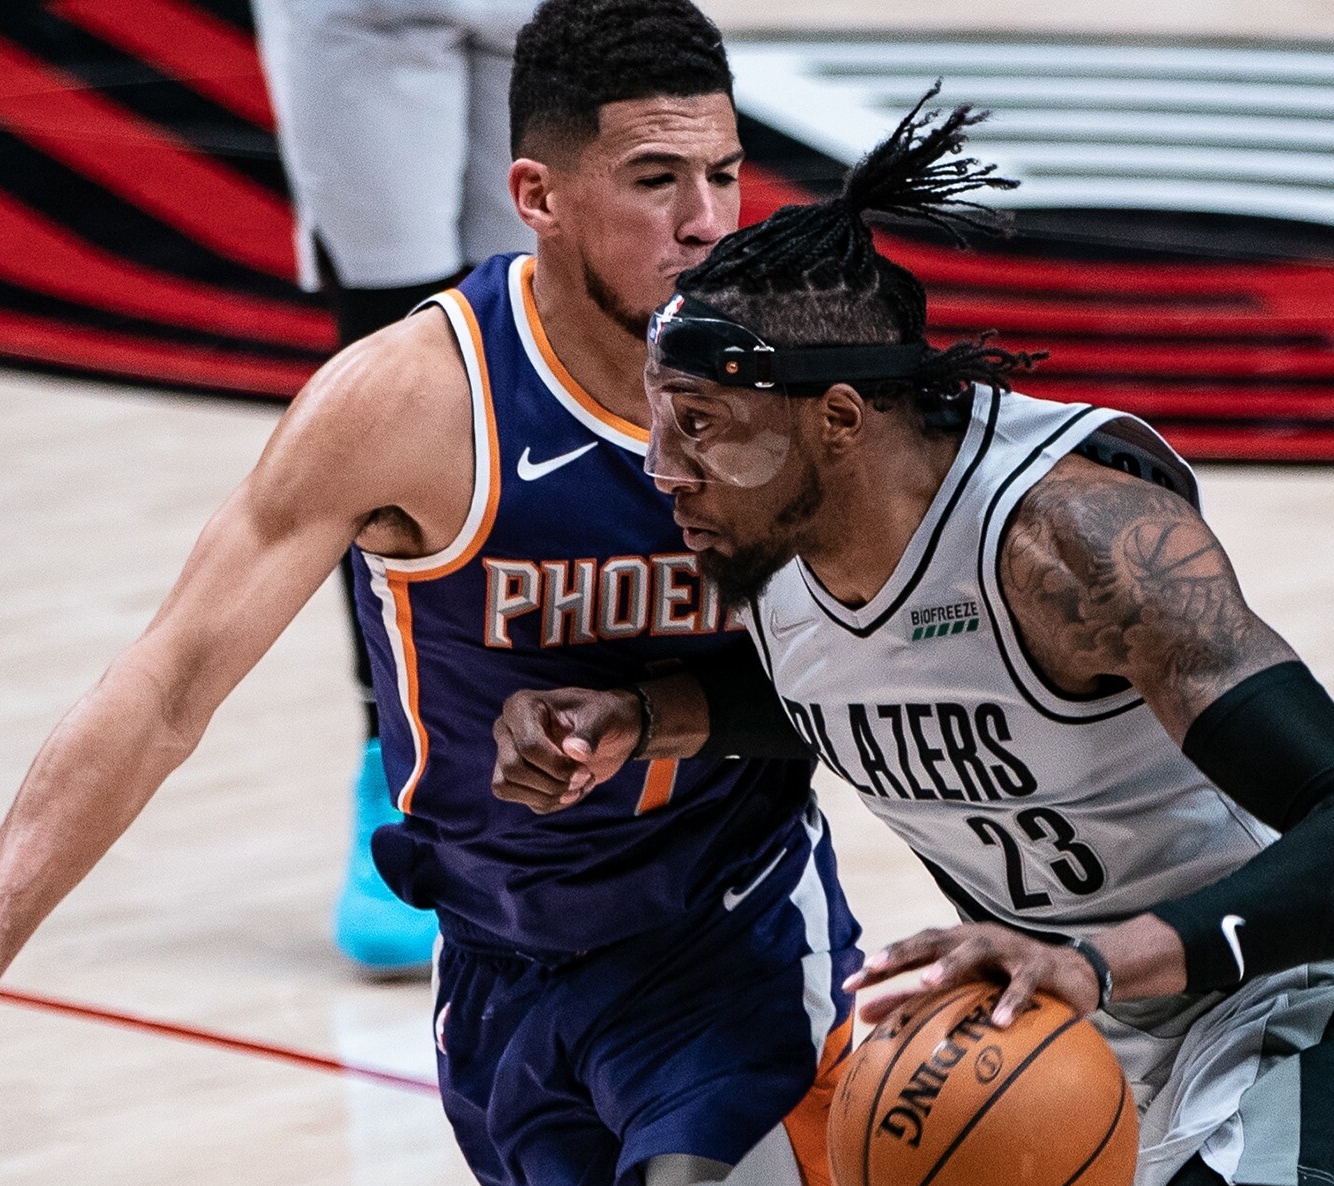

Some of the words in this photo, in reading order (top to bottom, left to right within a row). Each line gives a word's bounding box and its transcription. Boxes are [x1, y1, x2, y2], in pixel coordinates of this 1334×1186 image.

[910, 601, 979, 626] BIOFREEZE
[965, 806, 1107, 911] 23
[876, 990, 1041, 1149] ALDING
